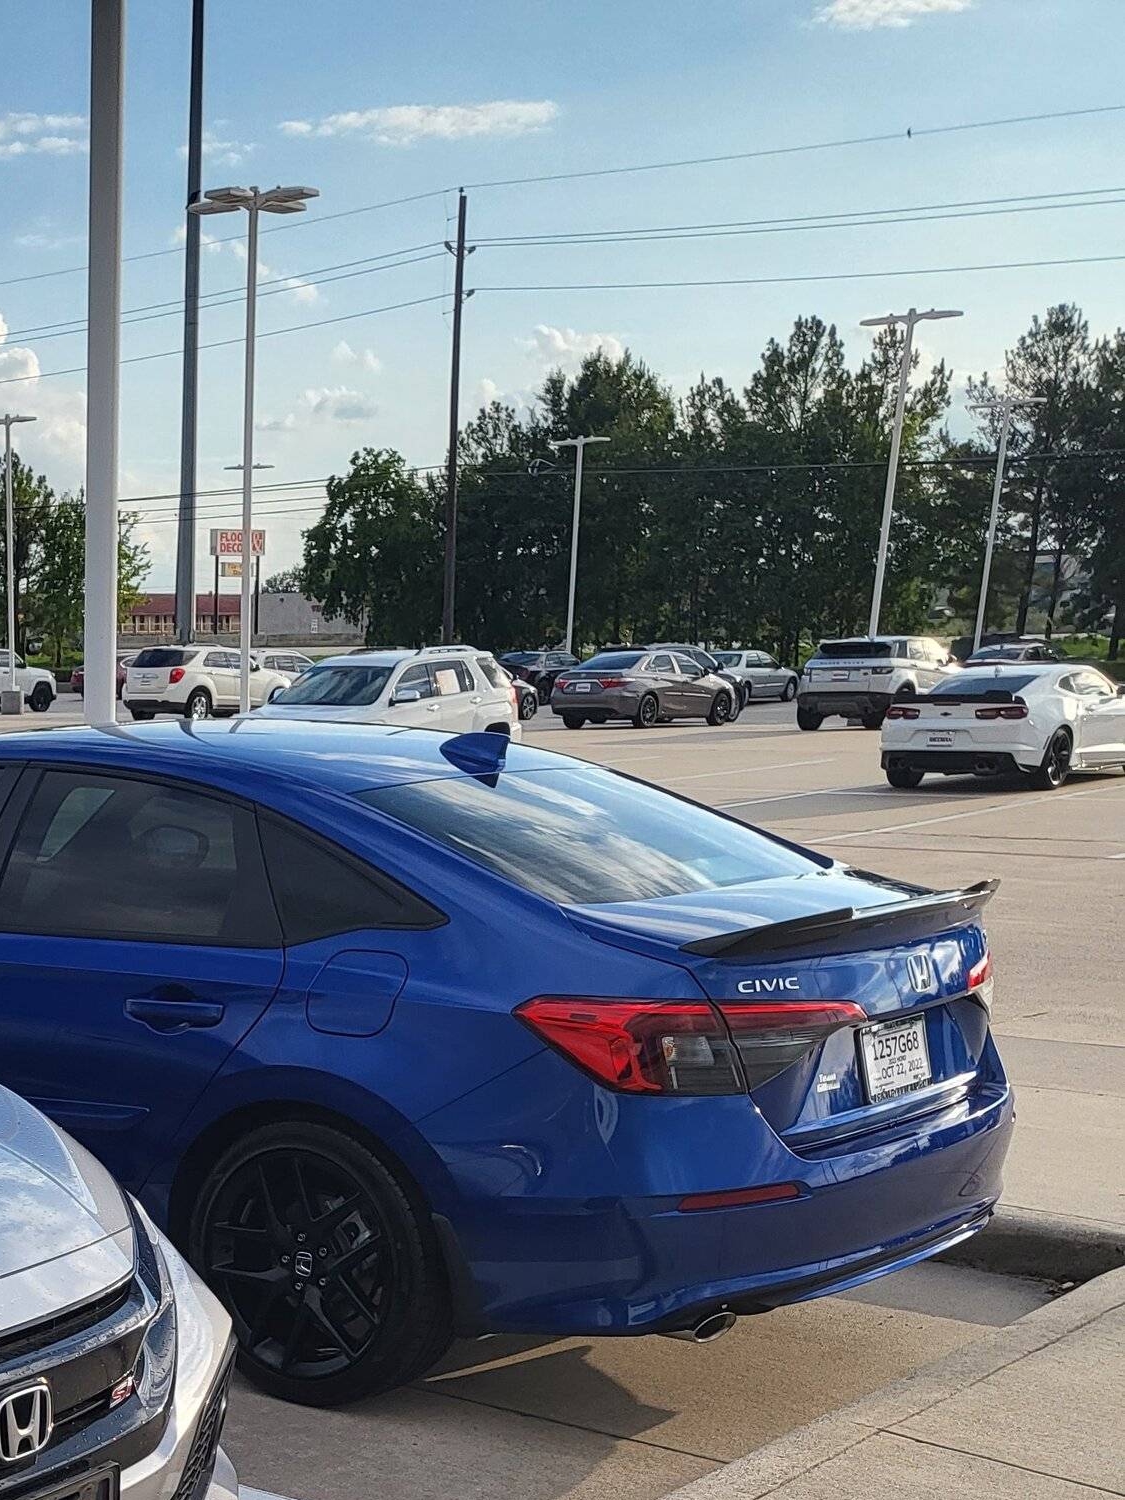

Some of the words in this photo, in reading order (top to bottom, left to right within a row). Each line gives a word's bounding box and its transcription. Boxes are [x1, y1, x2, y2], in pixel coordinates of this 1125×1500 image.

[220, 532, 243, 542] FLOO
[220, 543, 243, 553] DECO
[737, 977, 800, 993] CIVIC
[872, 1030, 920, 1061] 1257G68
[881, 1065, 895, 1079] OCT
[908, 1057, 924, 1072] 2022
